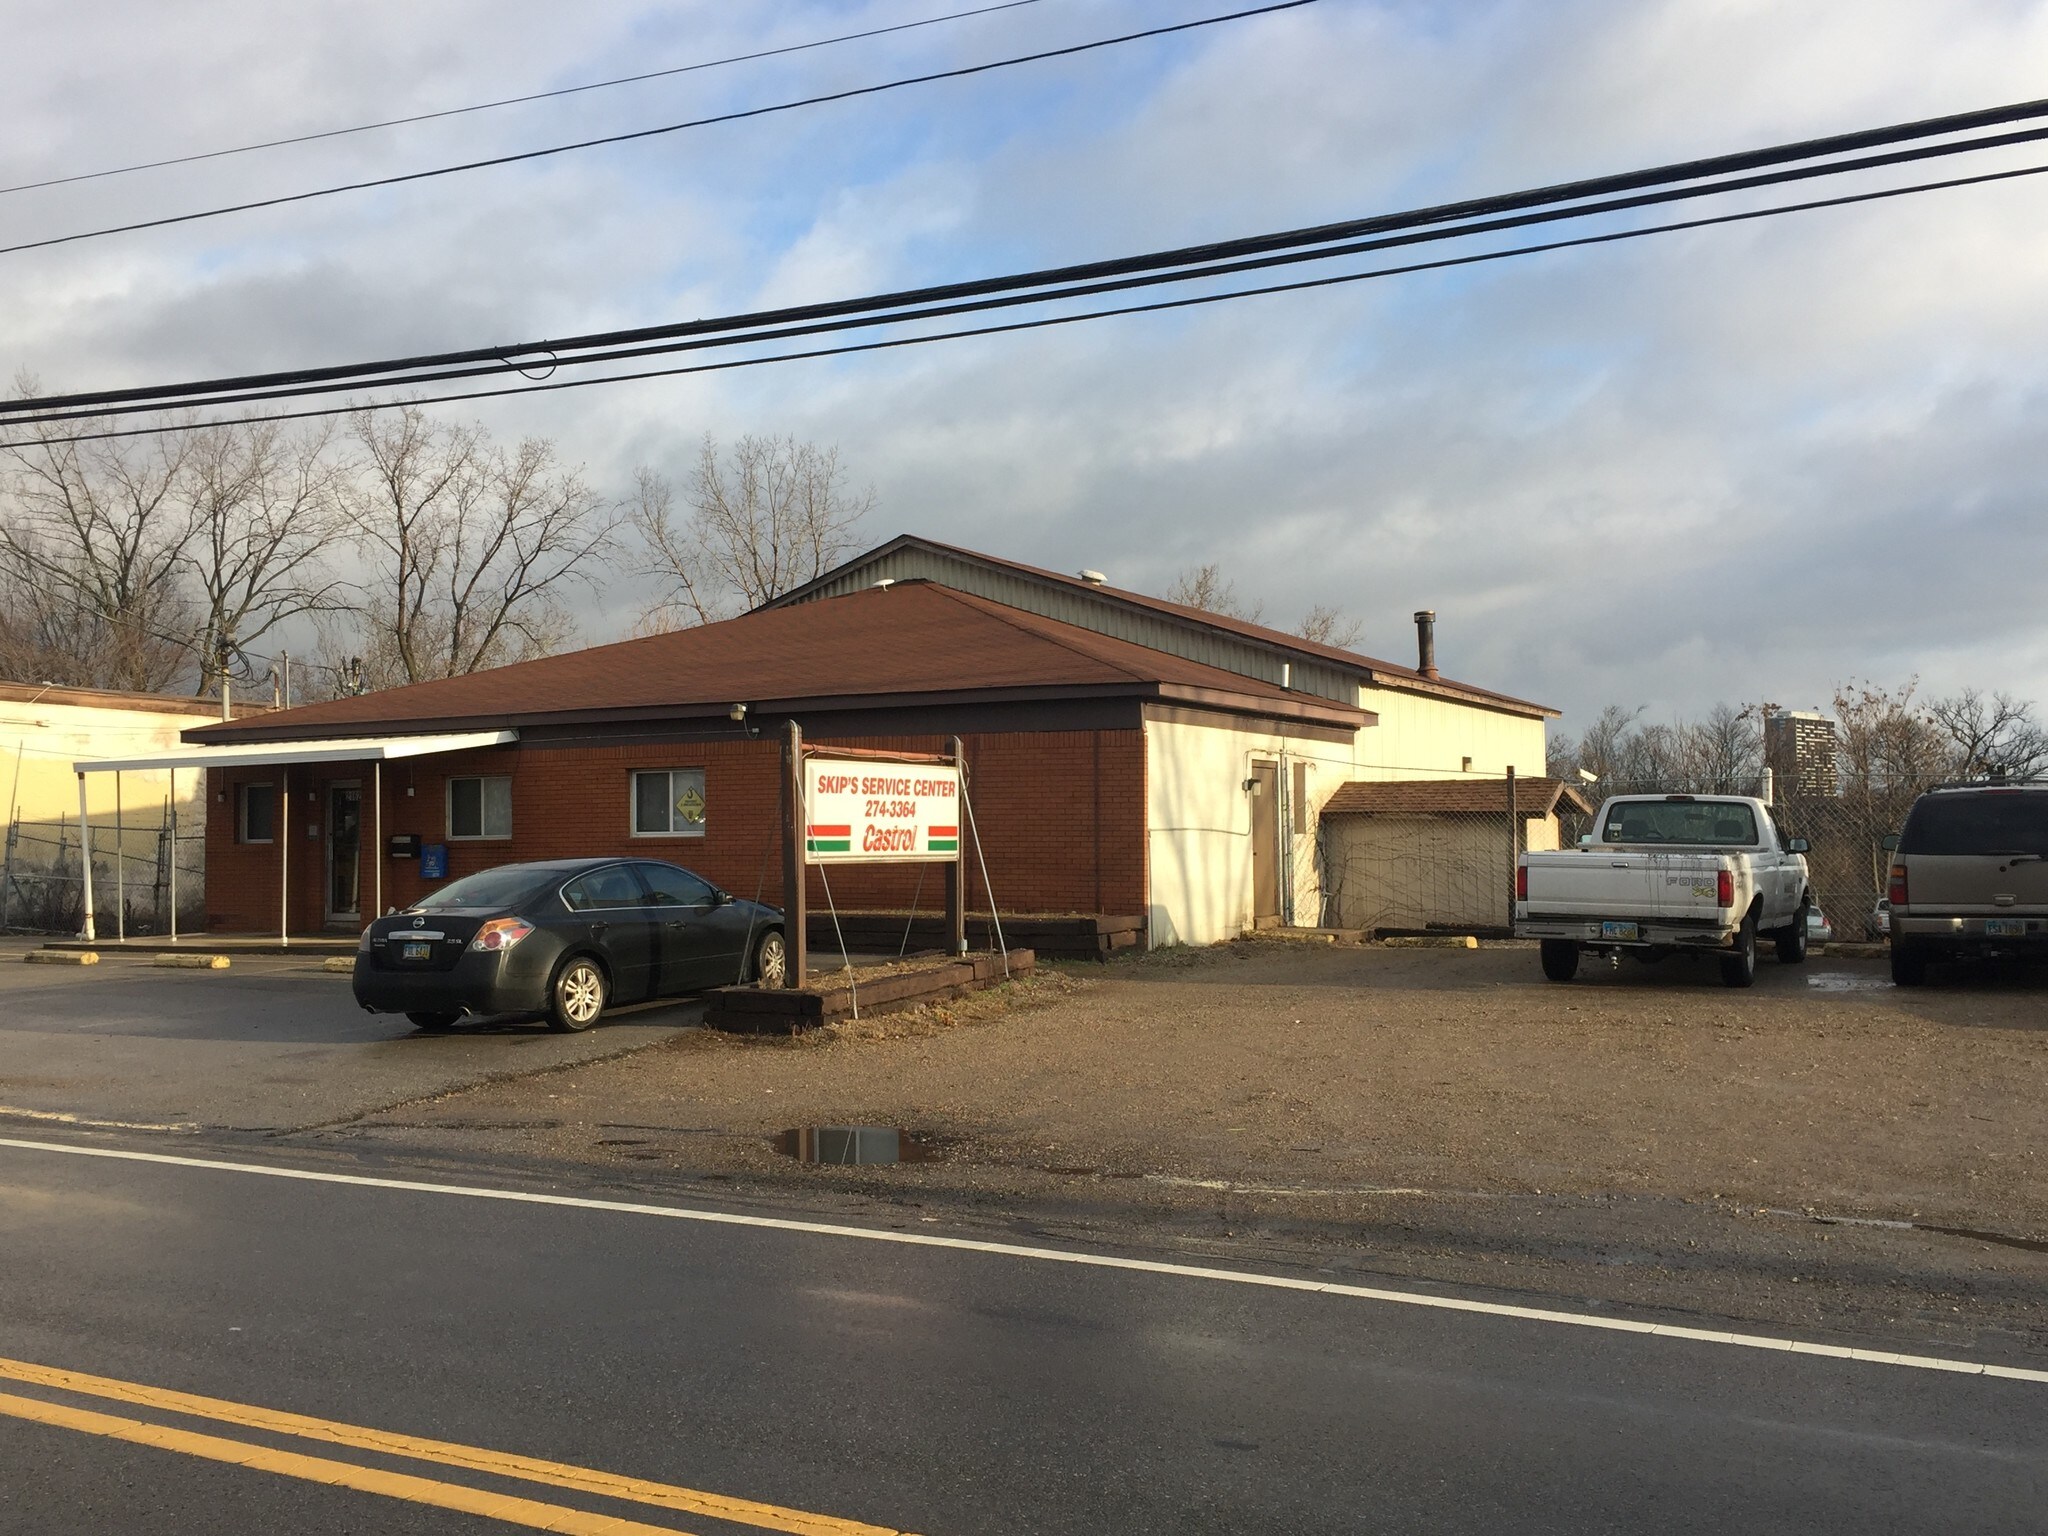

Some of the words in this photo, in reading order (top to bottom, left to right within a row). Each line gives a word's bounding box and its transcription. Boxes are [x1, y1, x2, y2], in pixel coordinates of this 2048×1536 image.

[818, 775, 858, 794] SKIP'S
[862, 777, 910, 796] SERVICE
[914, 779, 955, 797] CENTER
[865, 800, 916, 818] 274-3364
[863, 824, 918, 852] Castrol
[1666, 877, 1716, 887] FORD
